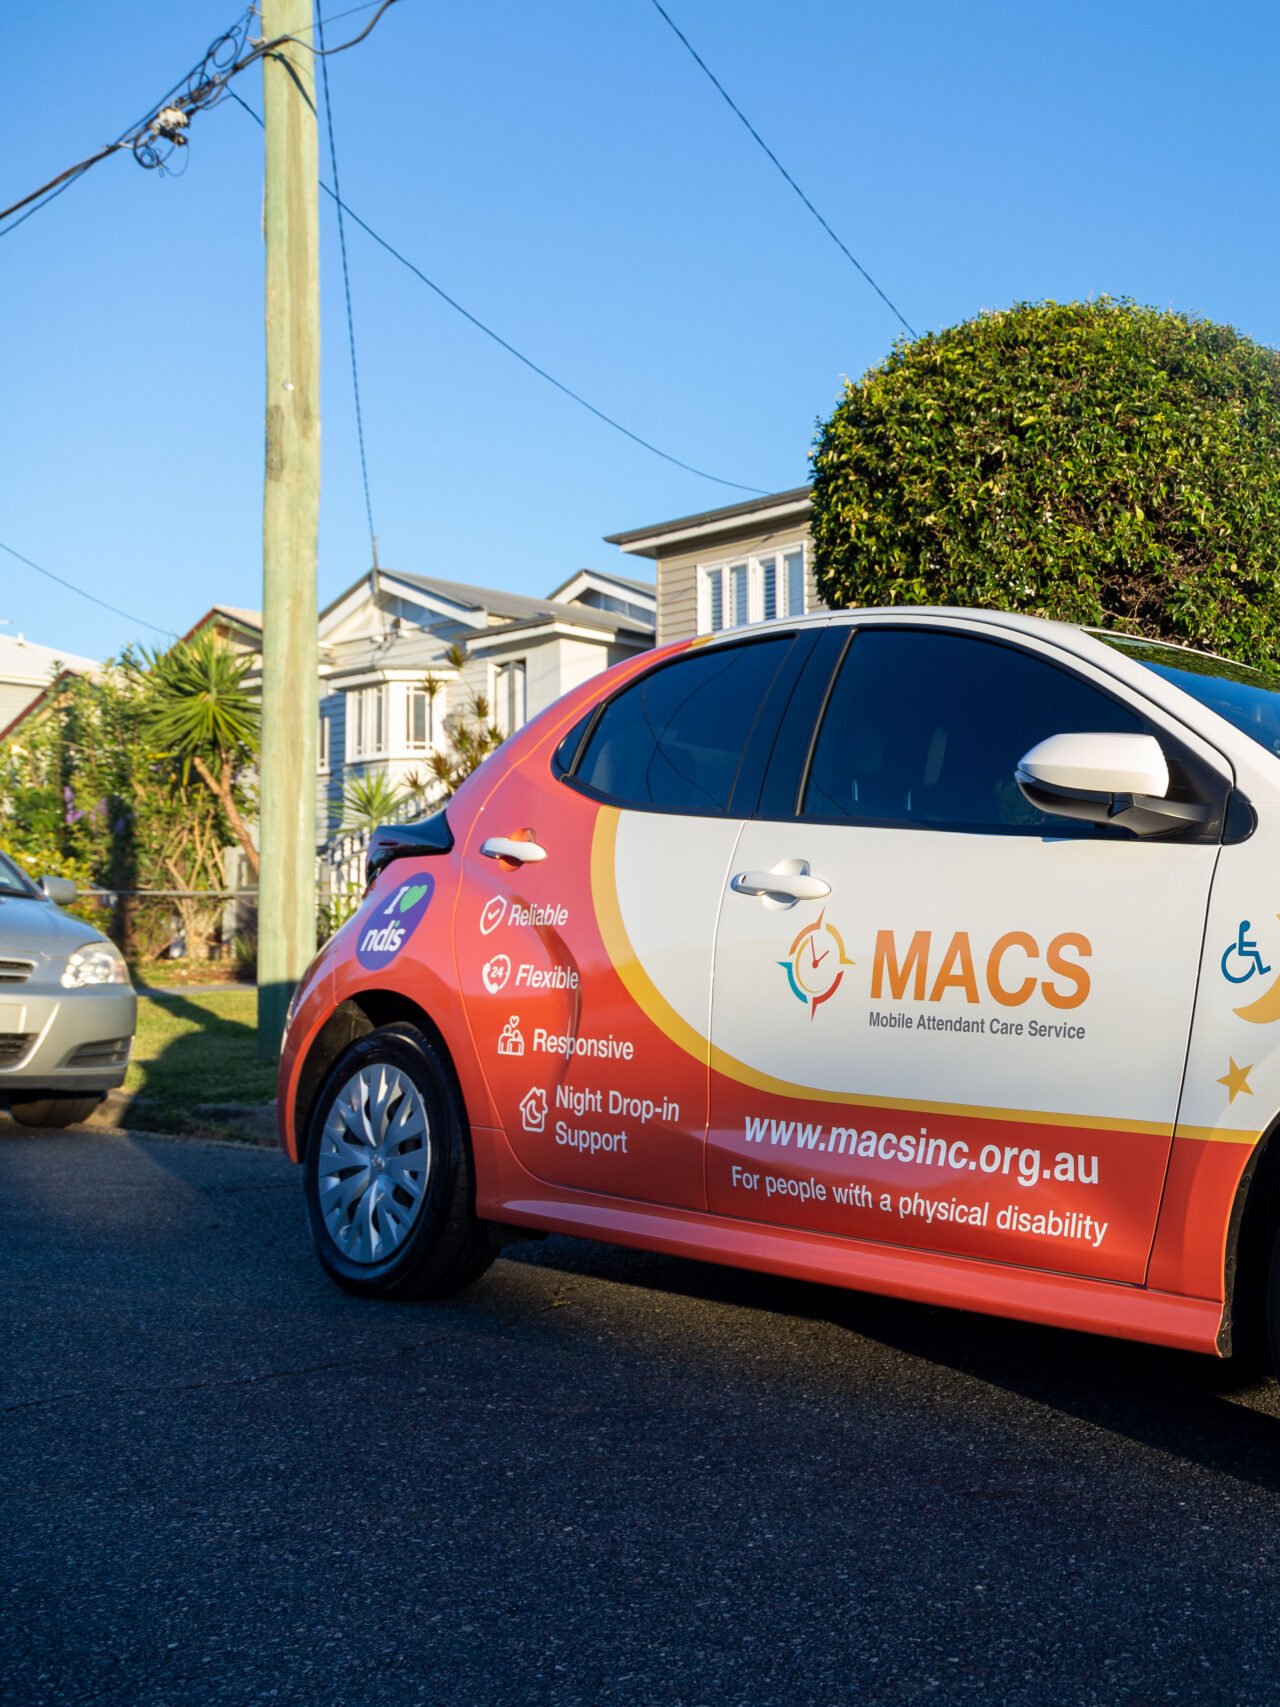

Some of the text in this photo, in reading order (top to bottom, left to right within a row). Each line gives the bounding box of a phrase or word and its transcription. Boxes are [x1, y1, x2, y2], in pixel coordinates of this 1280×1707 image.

[507, 903, 569, 926] Reliable
[360, 920, 406, 952] ndis
[490, 966, 504, 978] 24
[515, 963, 579, 990] Flexible
[870, 929, 1093, 1010] MACS
[869, 1011, 1086, 1040] Mobile Attendant Care Service
[533, 1028, 634, 1061] Responsive
[555, 1084, 680, 1123] Night Drop-in
[555, 1121, 628, 1153] Support
[744, 1115, 1100, 1187] www.macsinc.org.au
[731, 1165, 1109, 1248] For people with a physical disability
